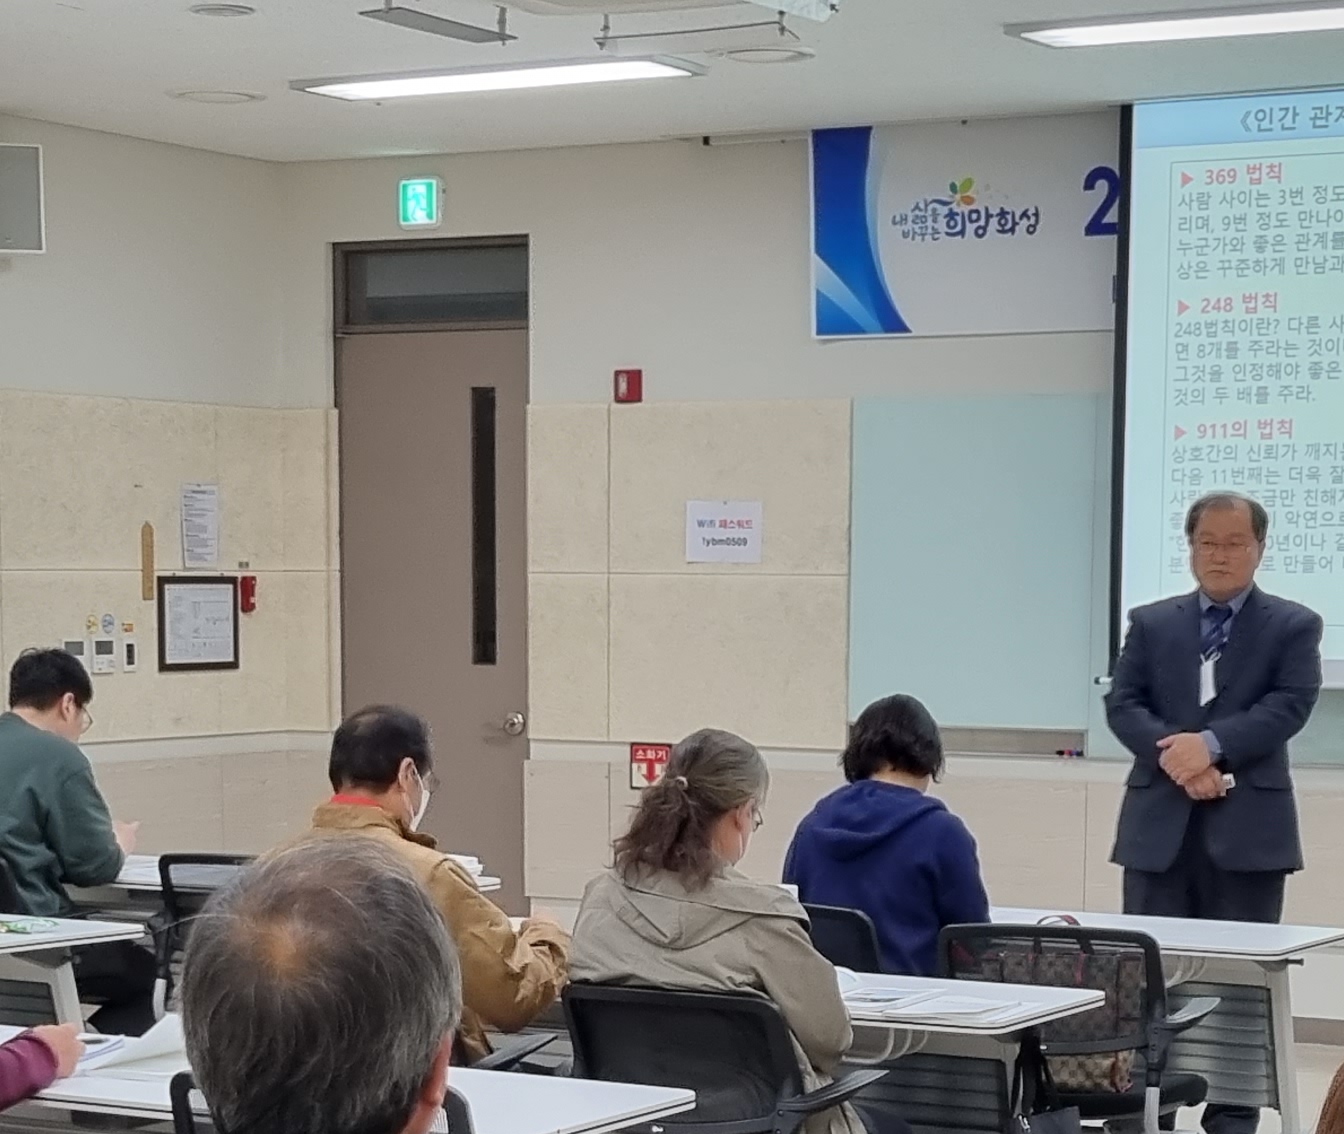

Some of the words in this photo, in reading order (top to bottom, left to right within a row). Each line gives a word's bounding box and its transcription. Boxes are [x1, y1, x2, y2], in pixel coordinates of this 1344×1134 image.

[1203, 167, 1237, 186] 369
[1245, 161, 1282, 186] 법칙
[1177, 190, 1213, 212] 사람
[1218, 187, 1272, 210] 사이는
[1277, 185, 1305, 208] 3번
[910, 199, 941, 225] 삶을
[1177, 213, 1215, 236] 리며,
[1220, 211, 1248, 234] 9번
[1255, 209, 1291, 232] 정도
[901, 225, 942, 242] 바꾸는
[1175, 234, 1246, 258] 누군가와
[1252, 232, 1288, 255] 좋은
[1175, 258, 1212, 281] 상은
[1215, 255, 1286, 279] 꾸준하게
[1200, 295, 1234, 314] 248
[1241, 290, 1278, 315] 법칙
[1173, 316, 1281, 340] 248법칙이란?
[1286, 314, 1322, 336] 다른
[1174, 341, 1190, 362] 면
[1195, 339, 1241, 361] 8개를
[1246, 337, 1301, 359] 주라는
[1172, 362, 1225, 384] 그것을
[1231, 360, 1301, 383] 인정해야
[1306, 359, 1343, 380] 좋은
[1173, 386, 1206, 407] 것의
[1211, 385, 1230, 405] 두
[1235, 384, 1270, 405] 배를
[1276, 383, 1316, 404] 주라.
[1196, 419, 1248, 441] 911의
[1256, 417, 1293, 440] 법칙
[1171, 443, 1238, 464] 상호간의
[1245, 442, 1298, 463] 신뢰가
[1170, 466, 1205, 486] 다음
[1210, 465, 1282, 486] 11번째는
[1287, 465, 1323, 484] 더욱
[718, 518, 753, 530] 패스워드
[1282, 553, 1334, 574] 만들어
[635, 748, 667, 761] 소화기
